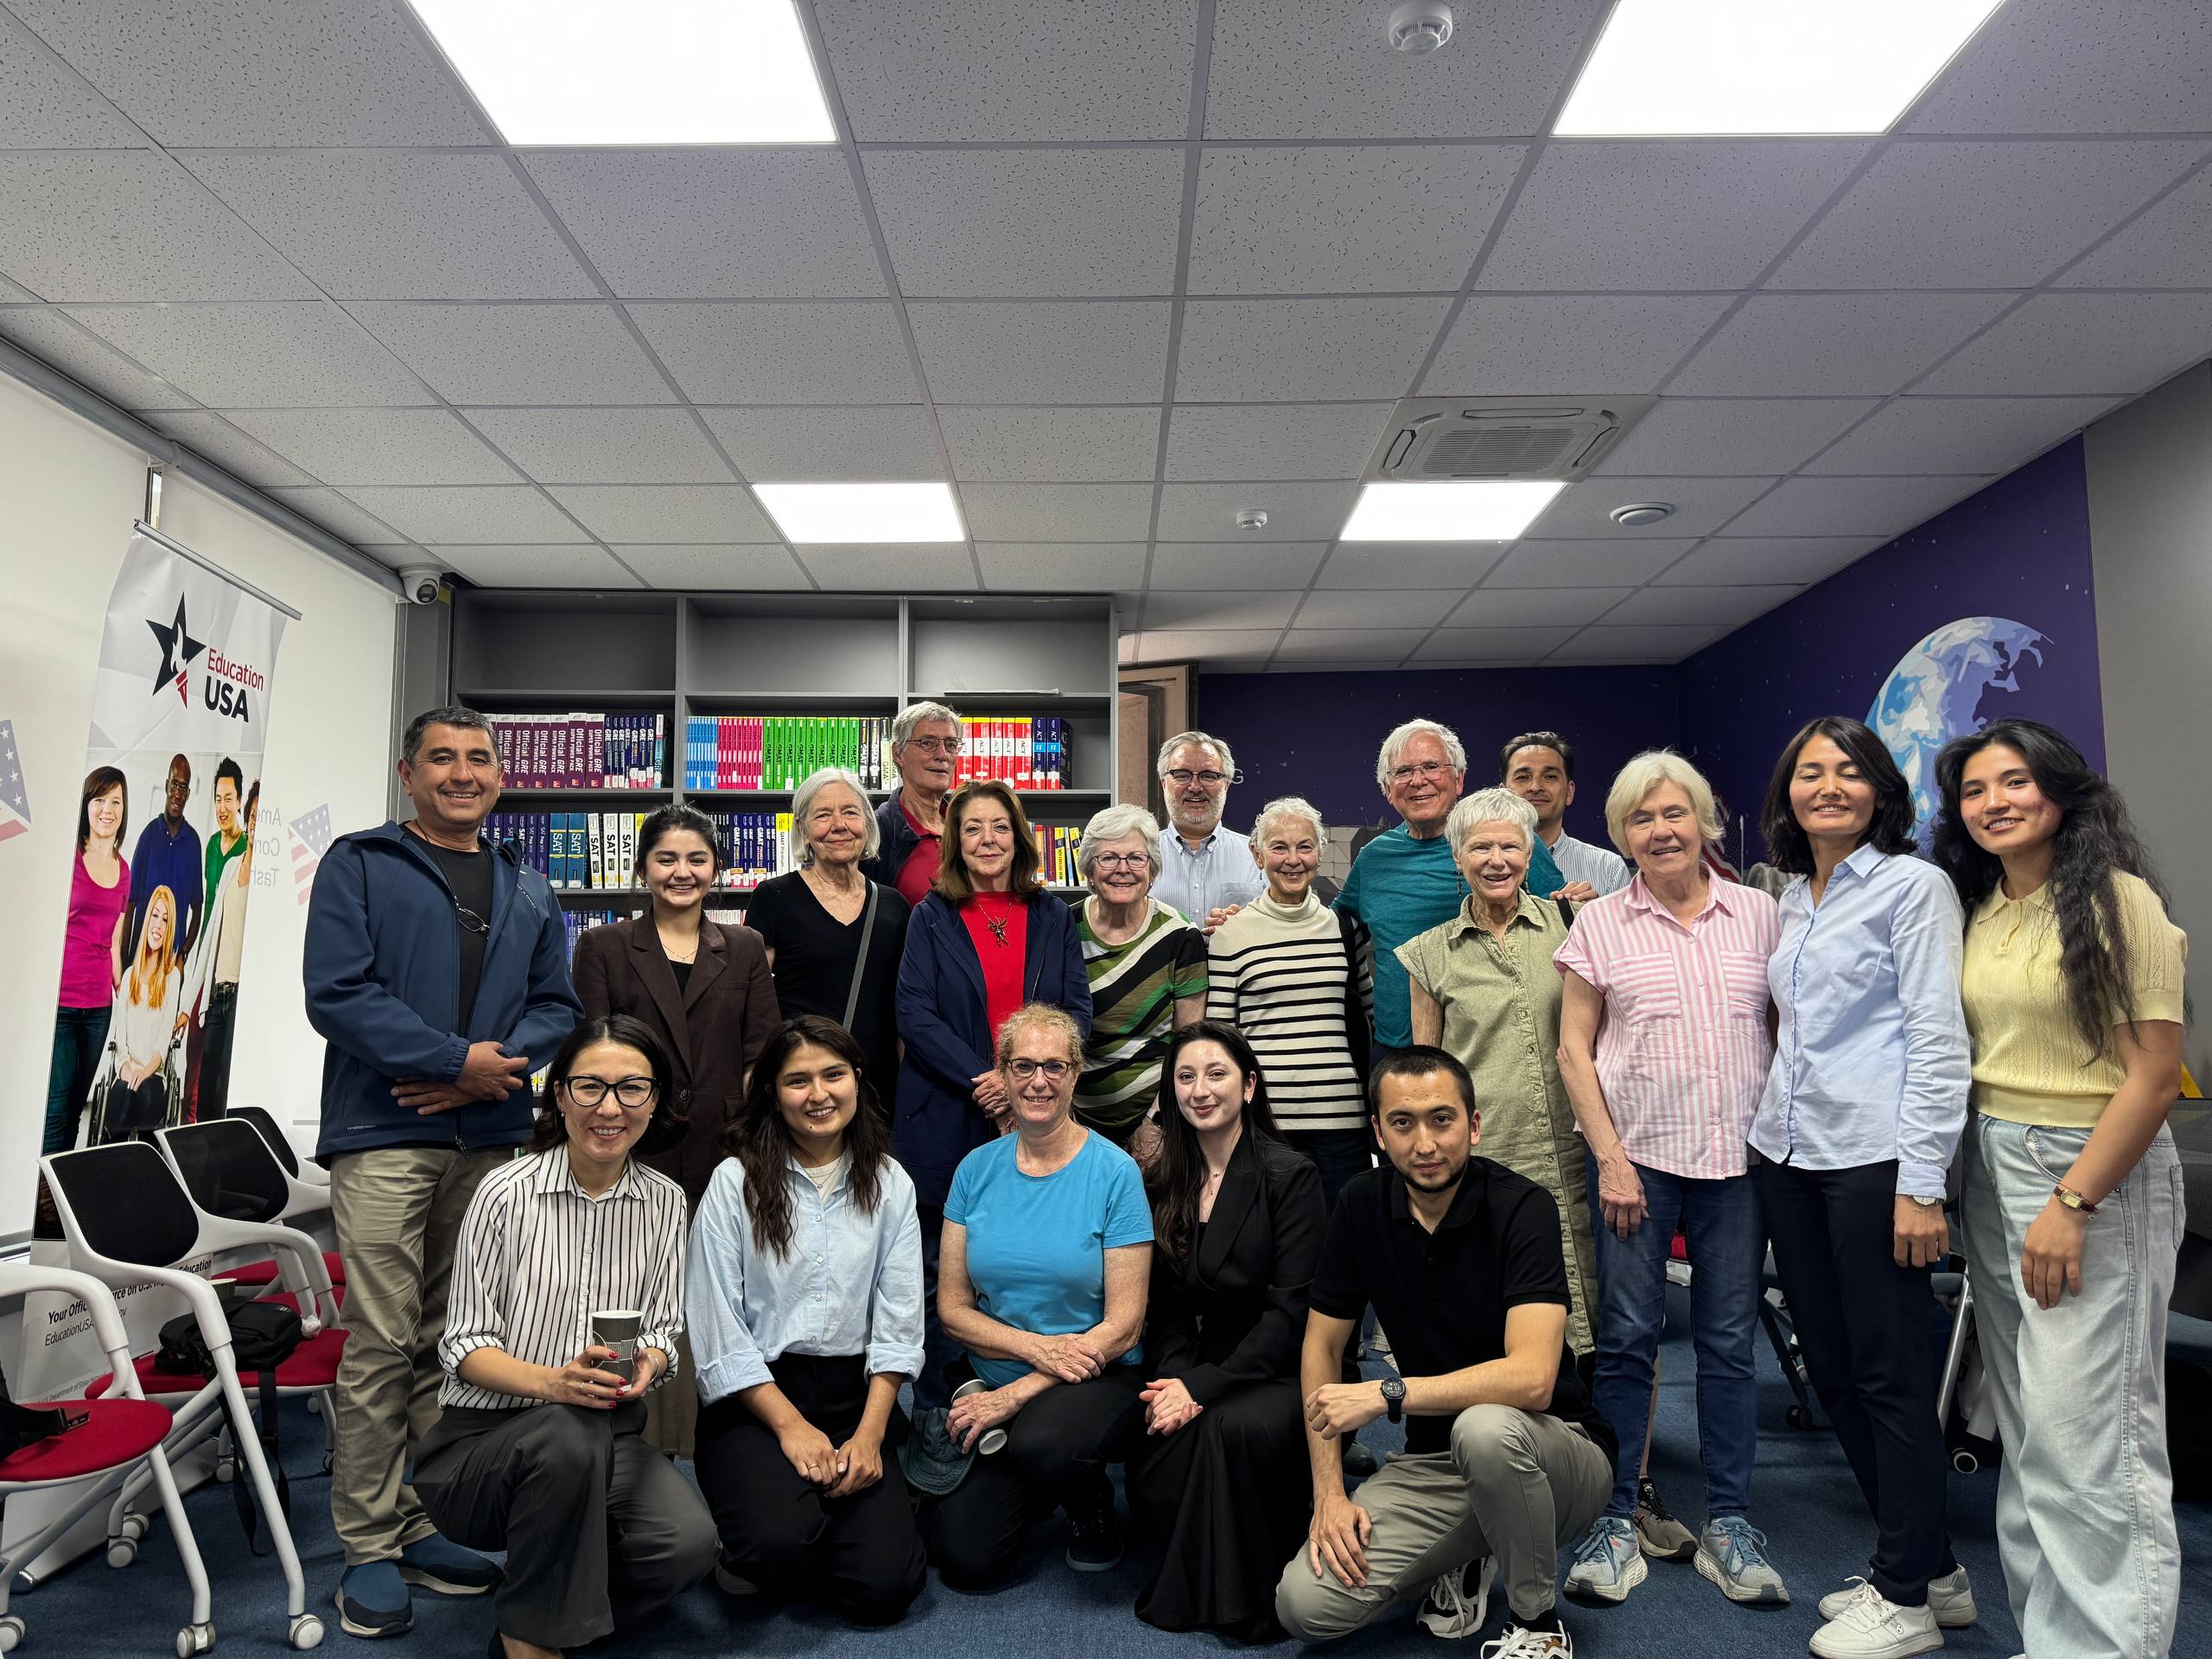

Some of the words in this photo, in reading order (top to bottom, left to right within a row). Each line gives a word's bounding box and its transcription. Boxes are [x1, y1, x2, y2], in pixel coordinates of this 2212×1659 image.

[207, 648, 264, 691] Education
[205, 675, 249, 722] USA
[503, 730, 512, 756] Official
[521, 730, 530, 756] Official
[539, 730, 548, 757] Official
[557, 730, 566, 757] Official
[575, 728, 584, 754] Official
[520, 760, 529, 775] GRE
[556, 760, 565, 775] GRE
[594, 759, 602, 774] GRE
[553, 833, 563, 854] SAT
[572, 833, 581, 854] SAT
[607, 835, 615, 855] SAT
[622, 835, 631, 855] SAT
[48, 1307, 67, 1325] Your
[68, 1300, 88, 1316] Offic
[113, 1289, 125, 1301] rce
[127, 1285, 137, 1296] on
